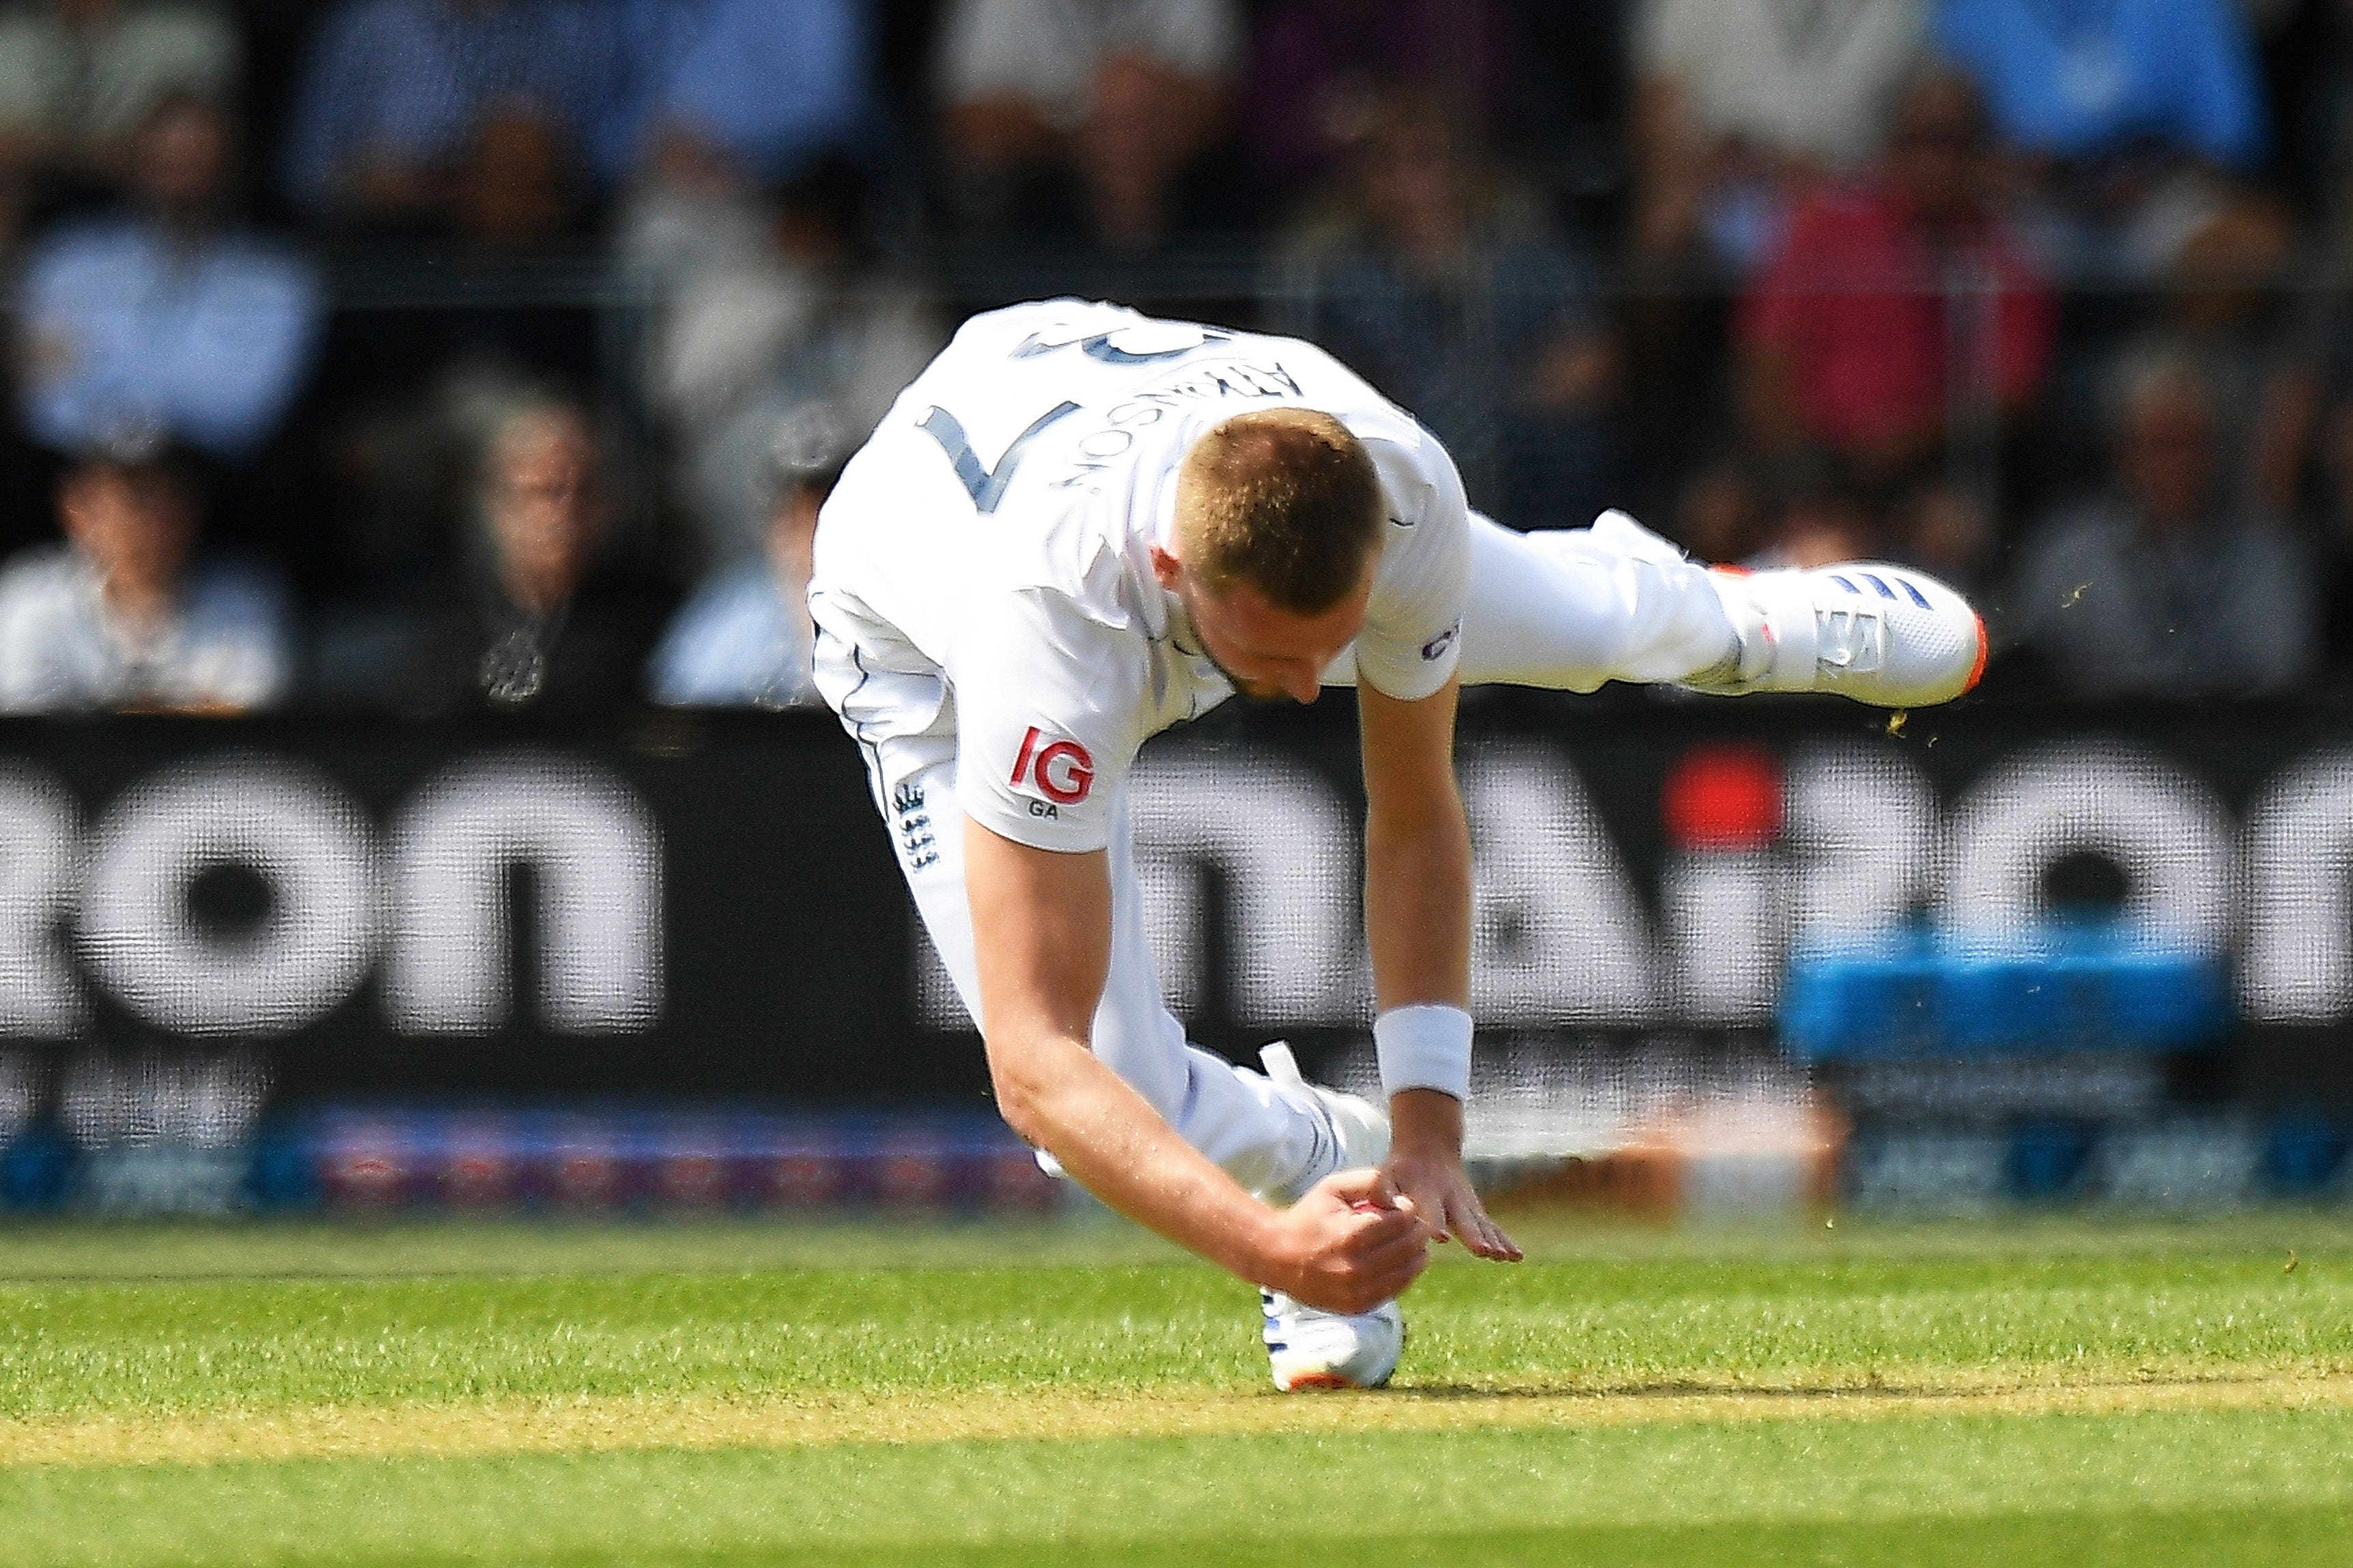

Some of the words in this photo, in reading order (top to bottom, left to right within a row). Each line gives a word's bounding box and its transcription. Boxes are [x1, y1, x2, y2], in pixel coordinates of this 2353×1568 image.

[1049, 361, 1304, 489] ATKINSON
[1009, 726, 1094, 804] IG
[1028, 800, 1058, 820] GA
